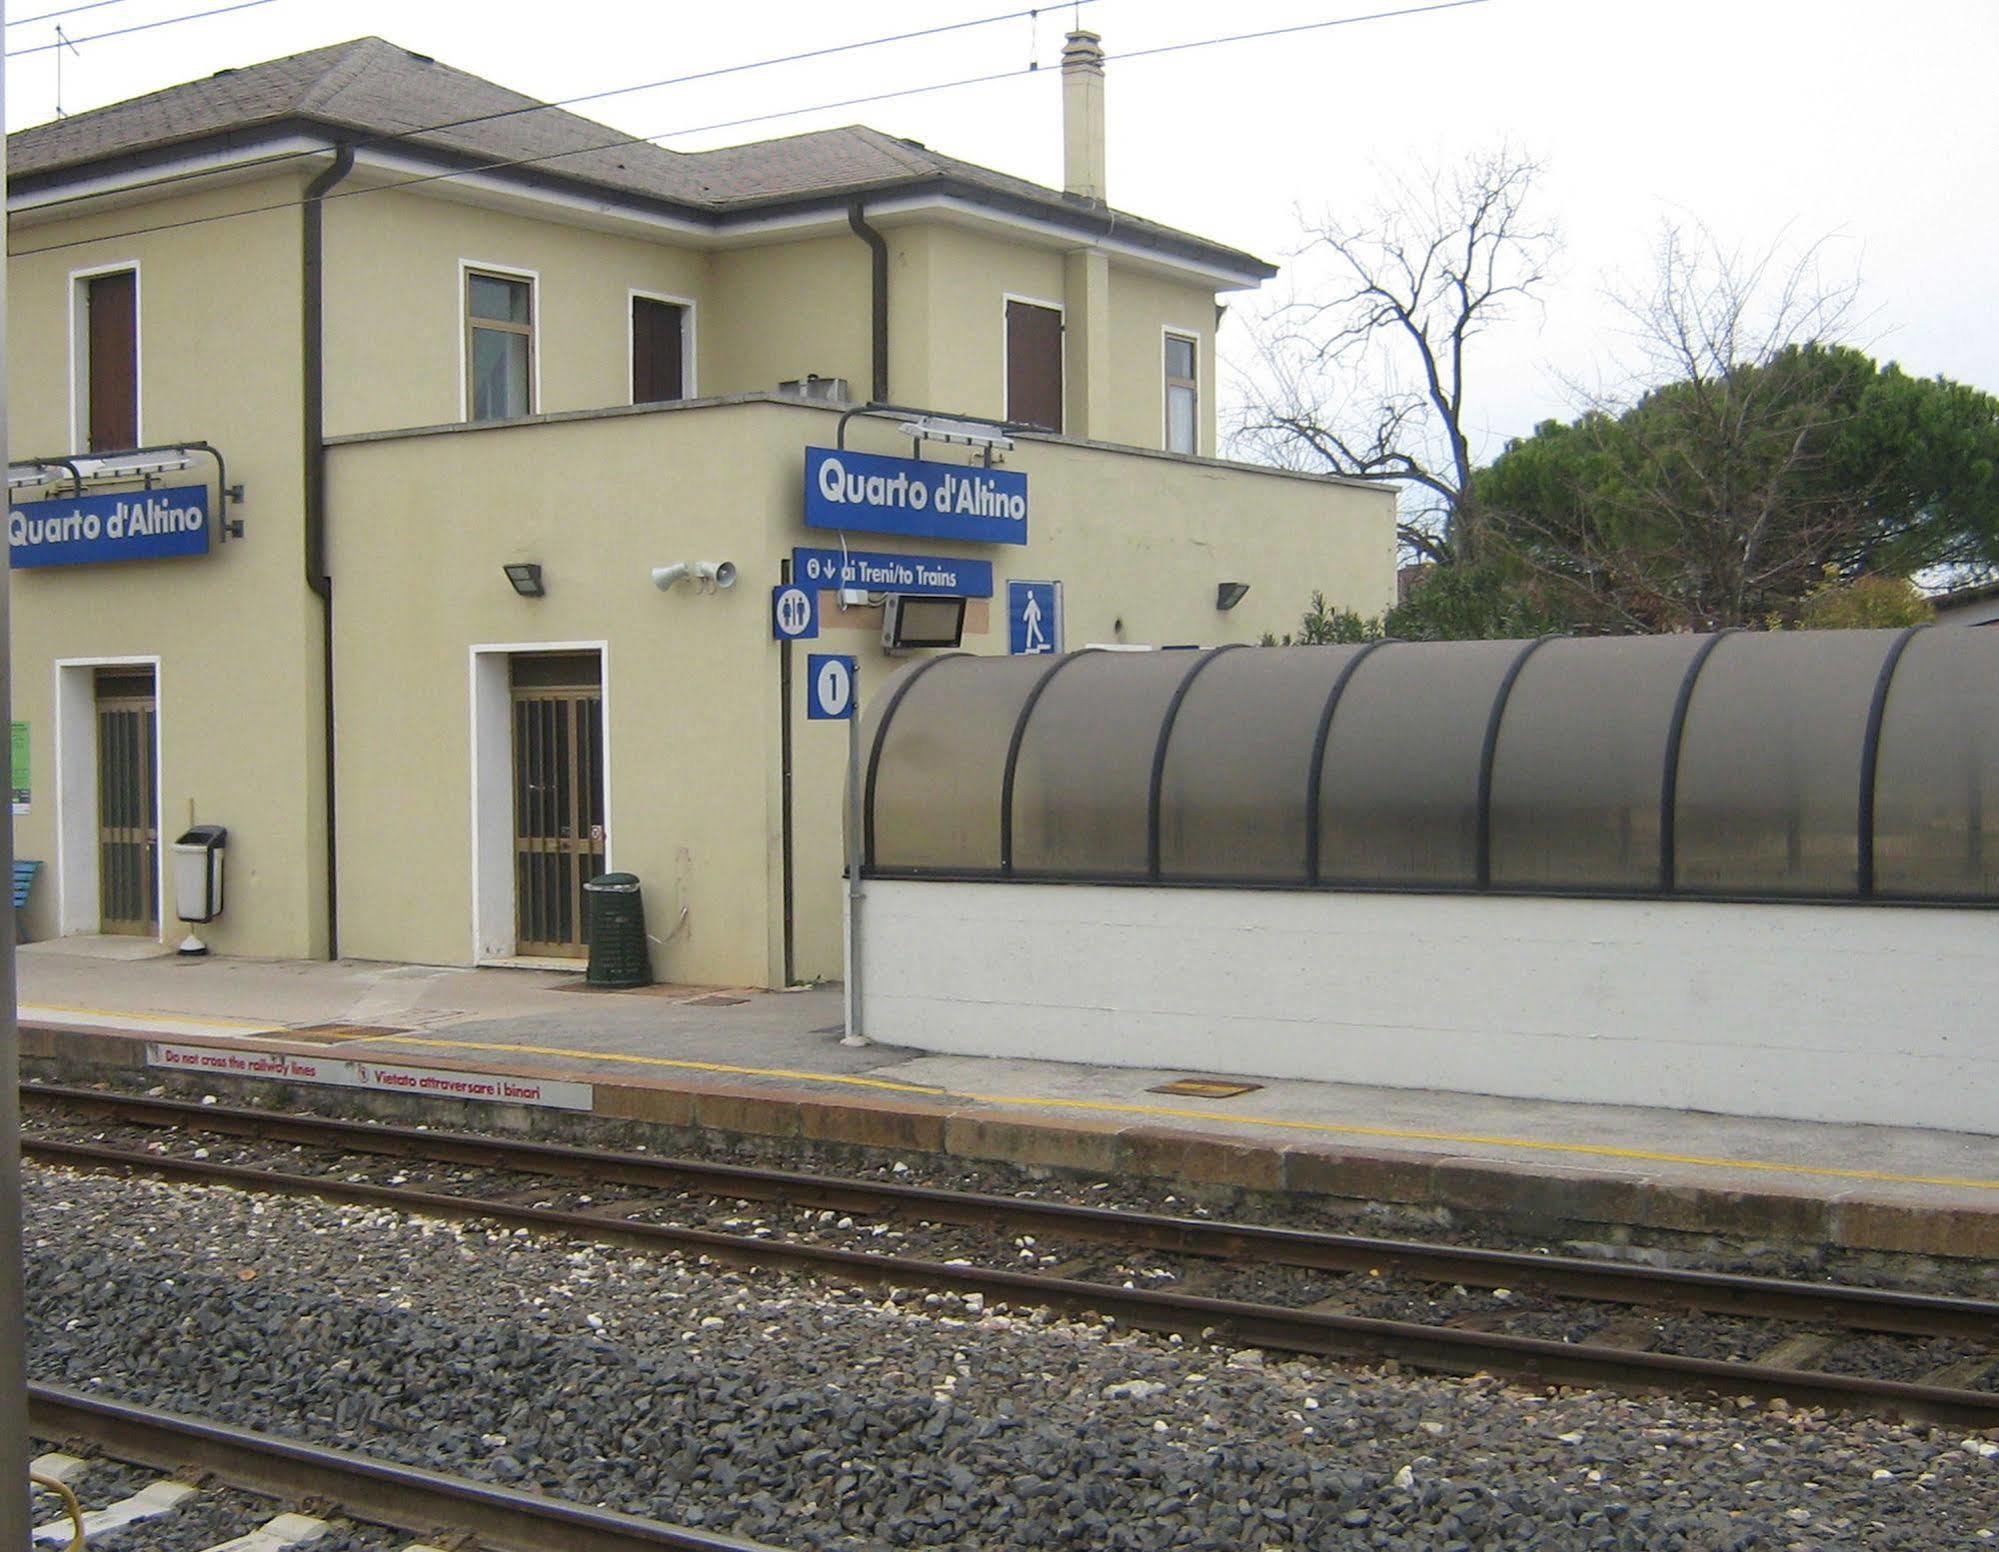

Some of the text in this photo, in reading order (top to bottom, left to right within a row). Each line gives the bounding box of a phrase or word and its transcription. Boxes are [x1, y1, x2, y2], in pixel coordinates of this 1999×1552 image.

[819, 458, 1026, 520] Quarto d'Altino
[8, 498, 204, 547] Quarto d'Altino
[843, 562, 957, 587] ai Treni/to Trains
[830, 673, 837, 701] 1
[165, 1050, 317, 1077] Do not cross the railway lines
[374, 1070, 542, 1100] Vietato attraversare i binari
